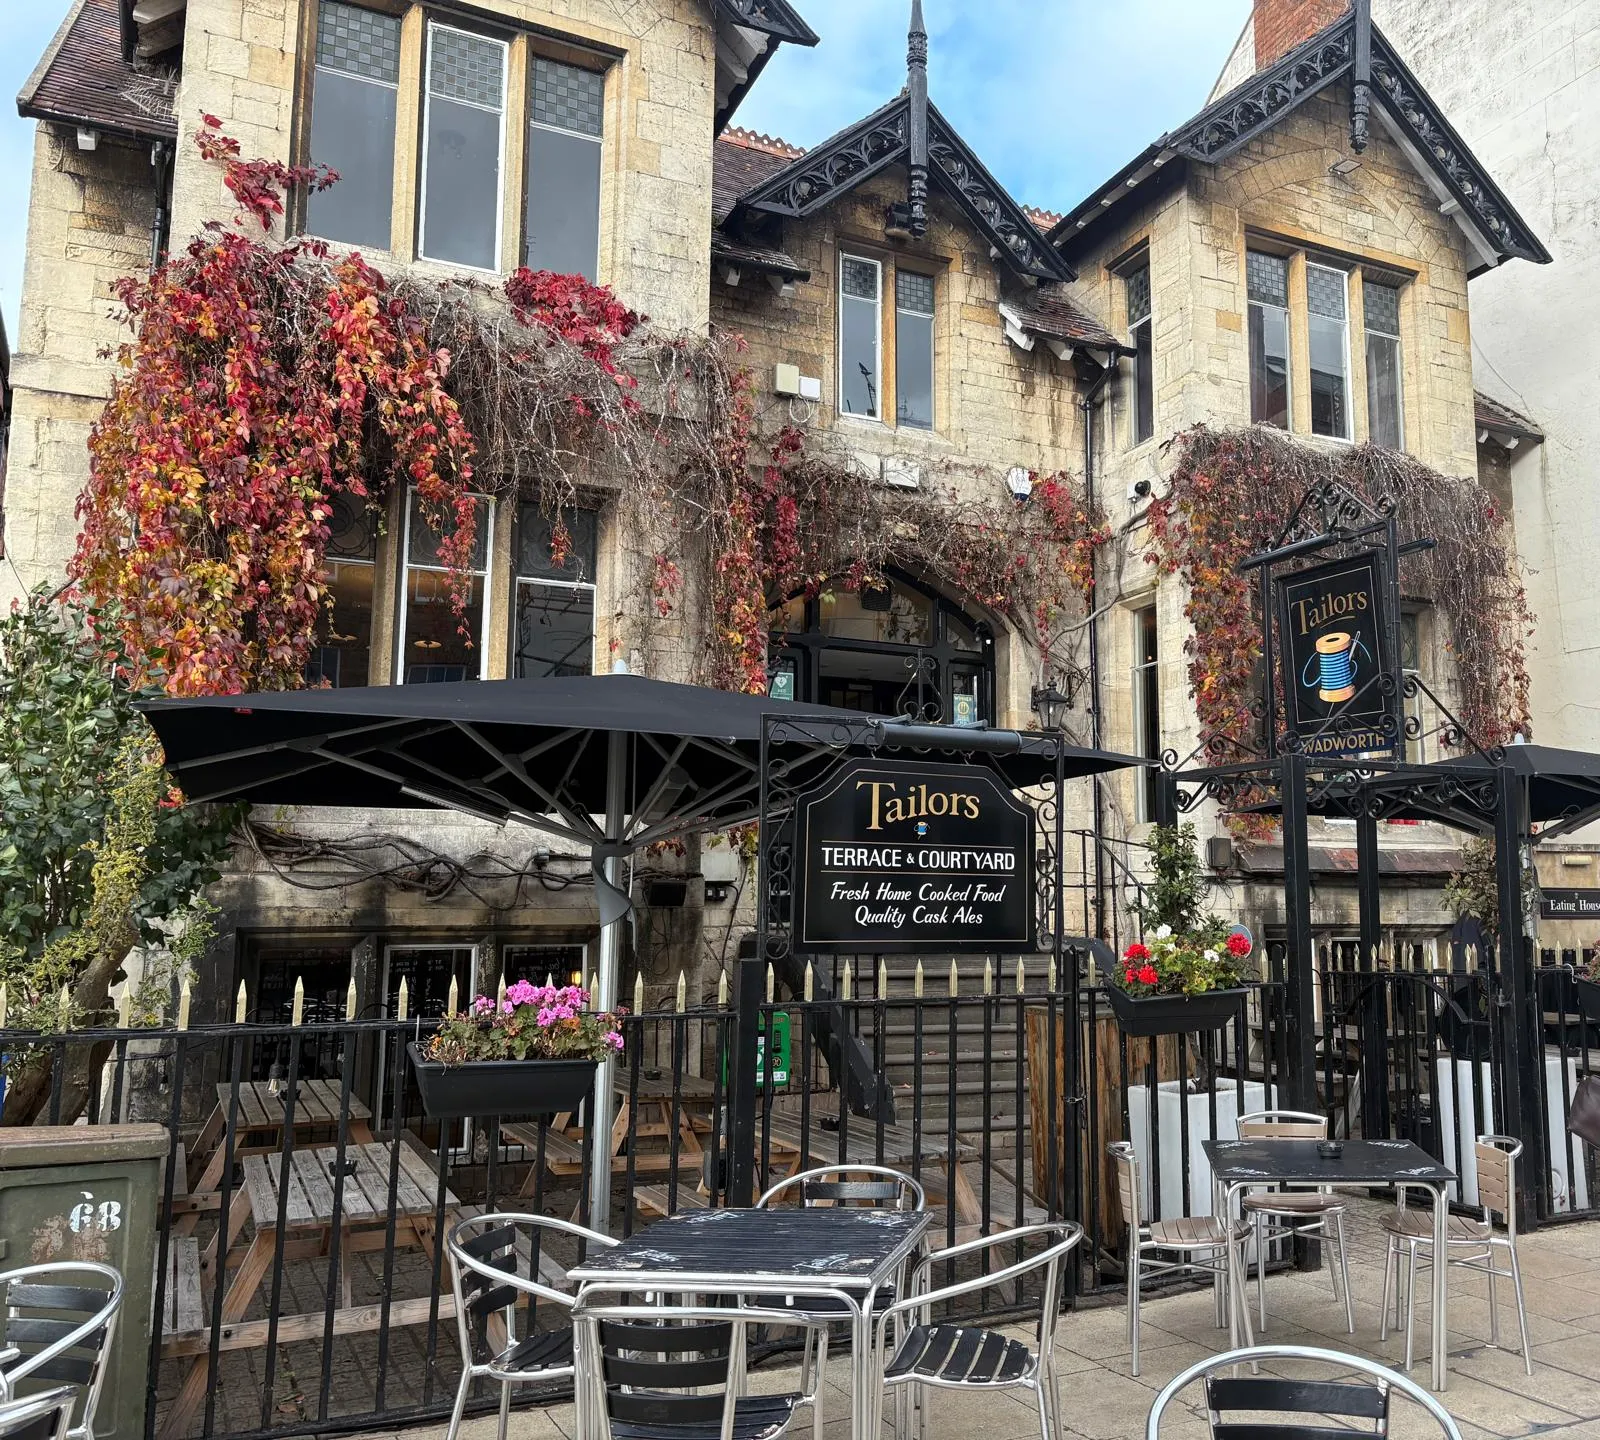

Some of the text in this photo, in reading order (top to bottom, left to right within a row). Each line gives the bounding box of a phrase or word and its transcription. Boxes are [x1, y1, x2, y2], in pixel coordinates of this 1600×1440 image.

[1290, 591, 1368, 636] Tailors
[1301, 732, 1385, 754] WADWORTH
[855, 780, 981, 831] Tailors
[821, 847, 1015, 871] TERRACE & COURTYARD
[830, 881, 1006, 902] Fresh Home Cooked Food
[854, 905, 983, 929] Quality Cask Ales
[1550, 899, 1600, 912] Eating Hous
